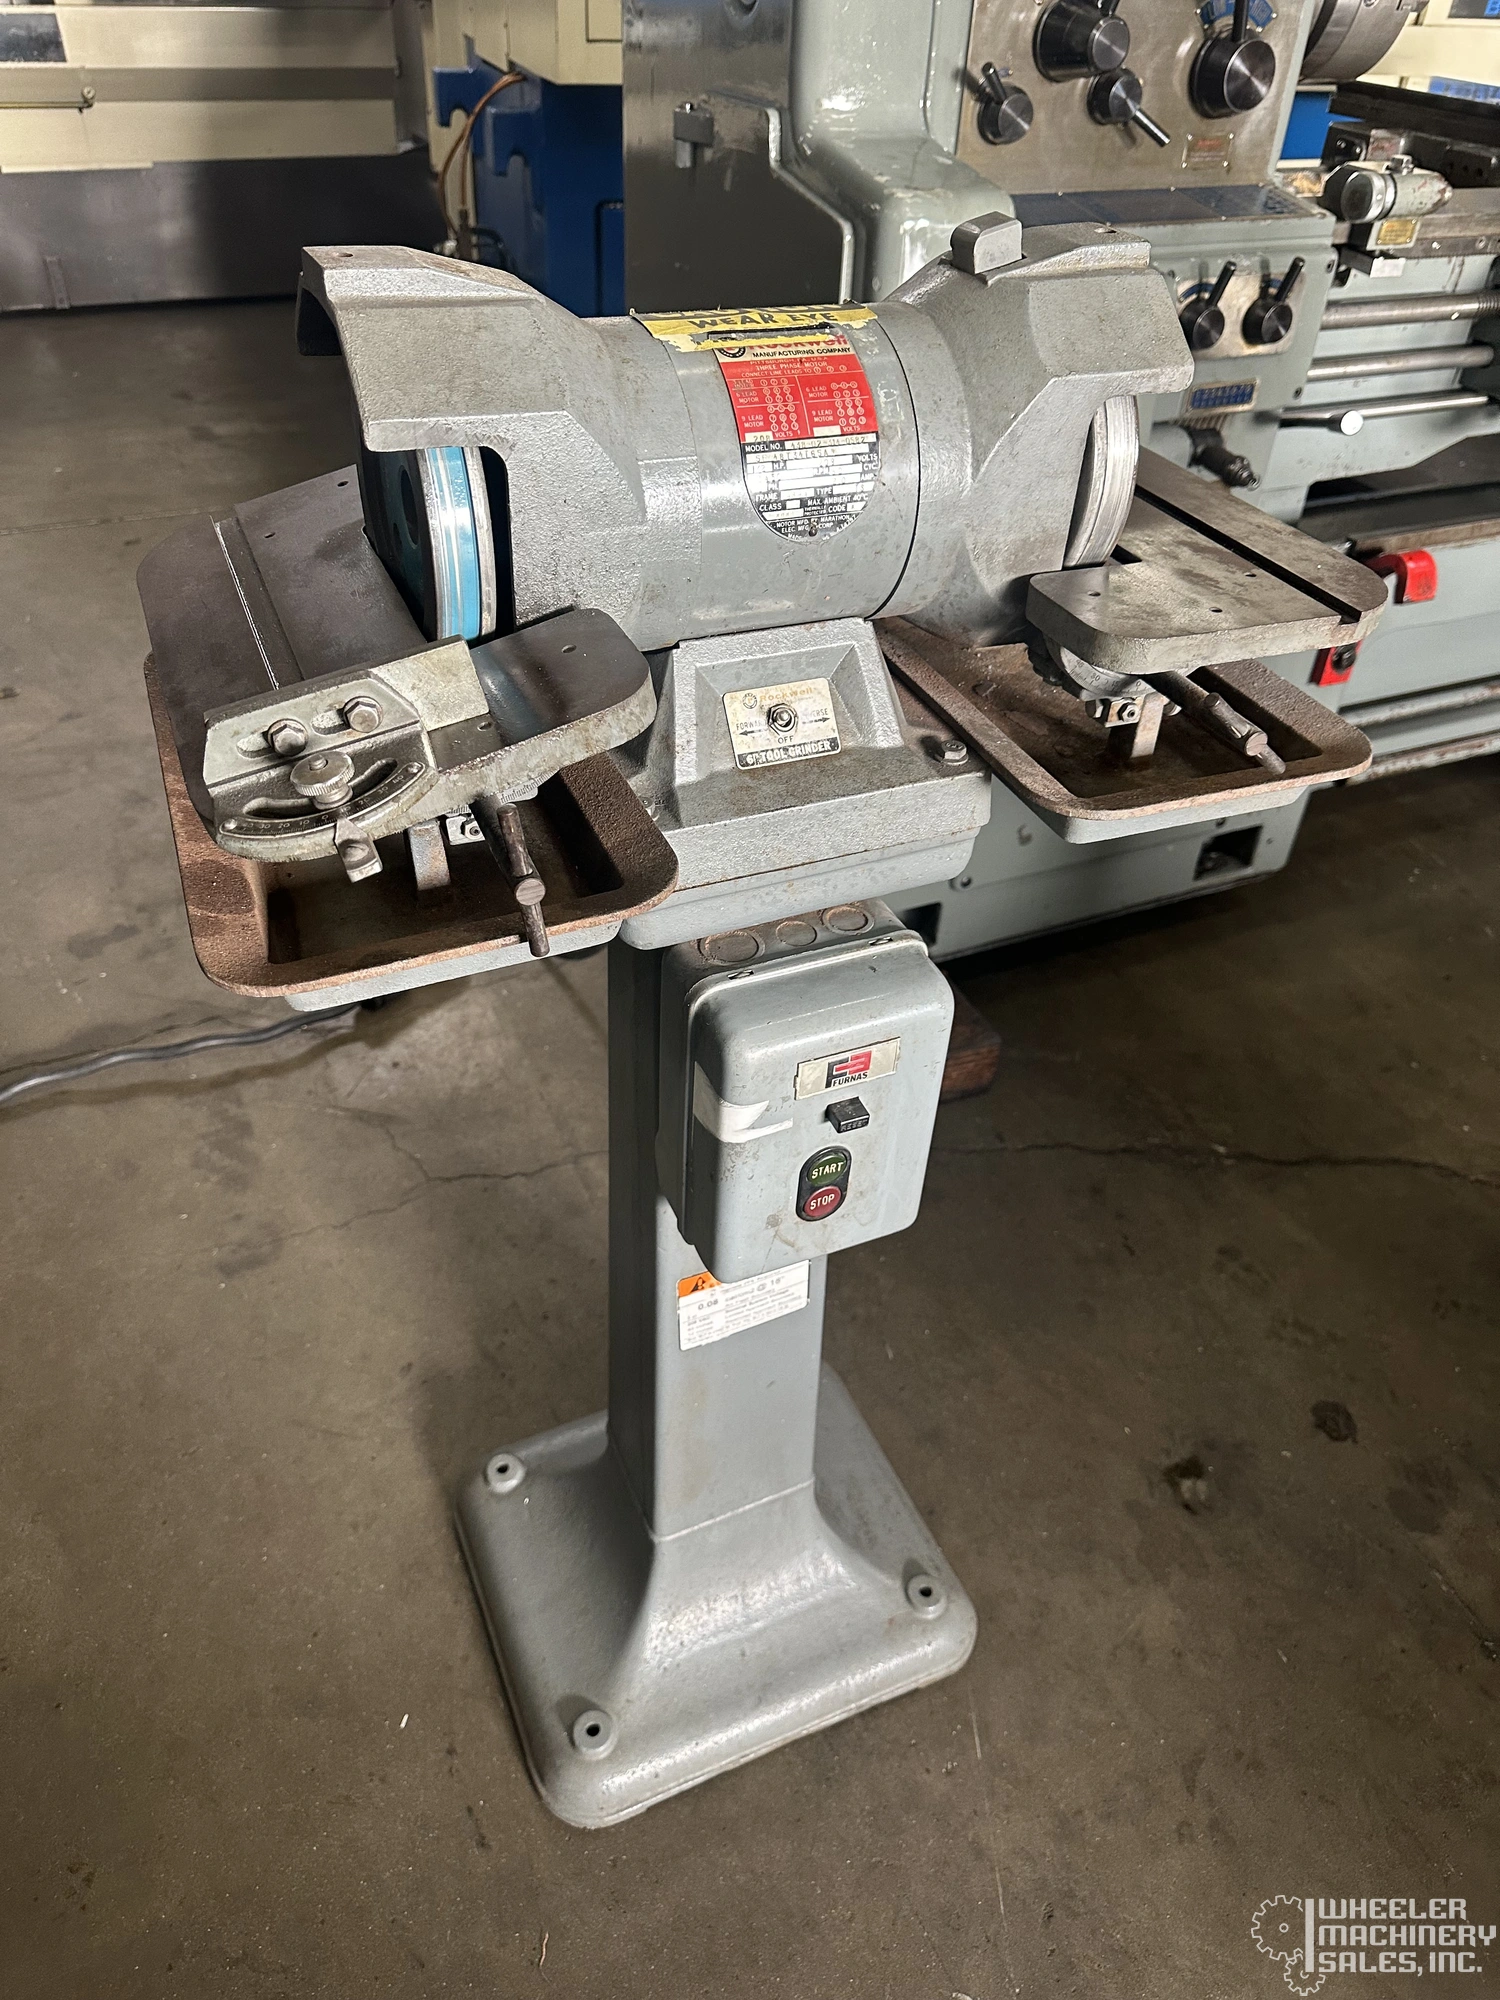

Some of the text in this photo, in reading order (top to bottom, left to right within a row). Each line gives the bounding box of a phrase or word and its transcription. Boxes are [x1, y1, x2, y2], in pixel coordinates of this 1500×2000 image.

[687, 312, 838, 329] WEAR EYE
[752, 346, 851, 358] MANUFACTURING COMPANY
[755, 363, 778, 371] THREE
[745, 443, 769, 452] MODEL
[770, 442, 783, 450] NO.
[773, 461, 786, 471] H.P.
[856, 453, 878, 463] VOLTS
[755, 491, 778, 501] FRAME
[816, 487, 833, 495] TYPE
[759, 502, 782, 511] CLASS
[807, 498, 823, 506] MAX.
[823, 495, 852, 504] AMBIENT
[828, 504, 846, 512] CODE
[776, 520, 796, 528] MOTOR
[820, 514, 850, 523] MARATHON
[760, 687, 813, 702] Rockwell
[778, 735, 794, 744] OFF
[761, 749, 788, 763] TOOL
[788, 740, 832, 757] GRINDER
[832, 1071, 868, 1087] FURNAS
[811, 1161, 844, 1180] START
[810, 1193, 835, 1210] STOP
